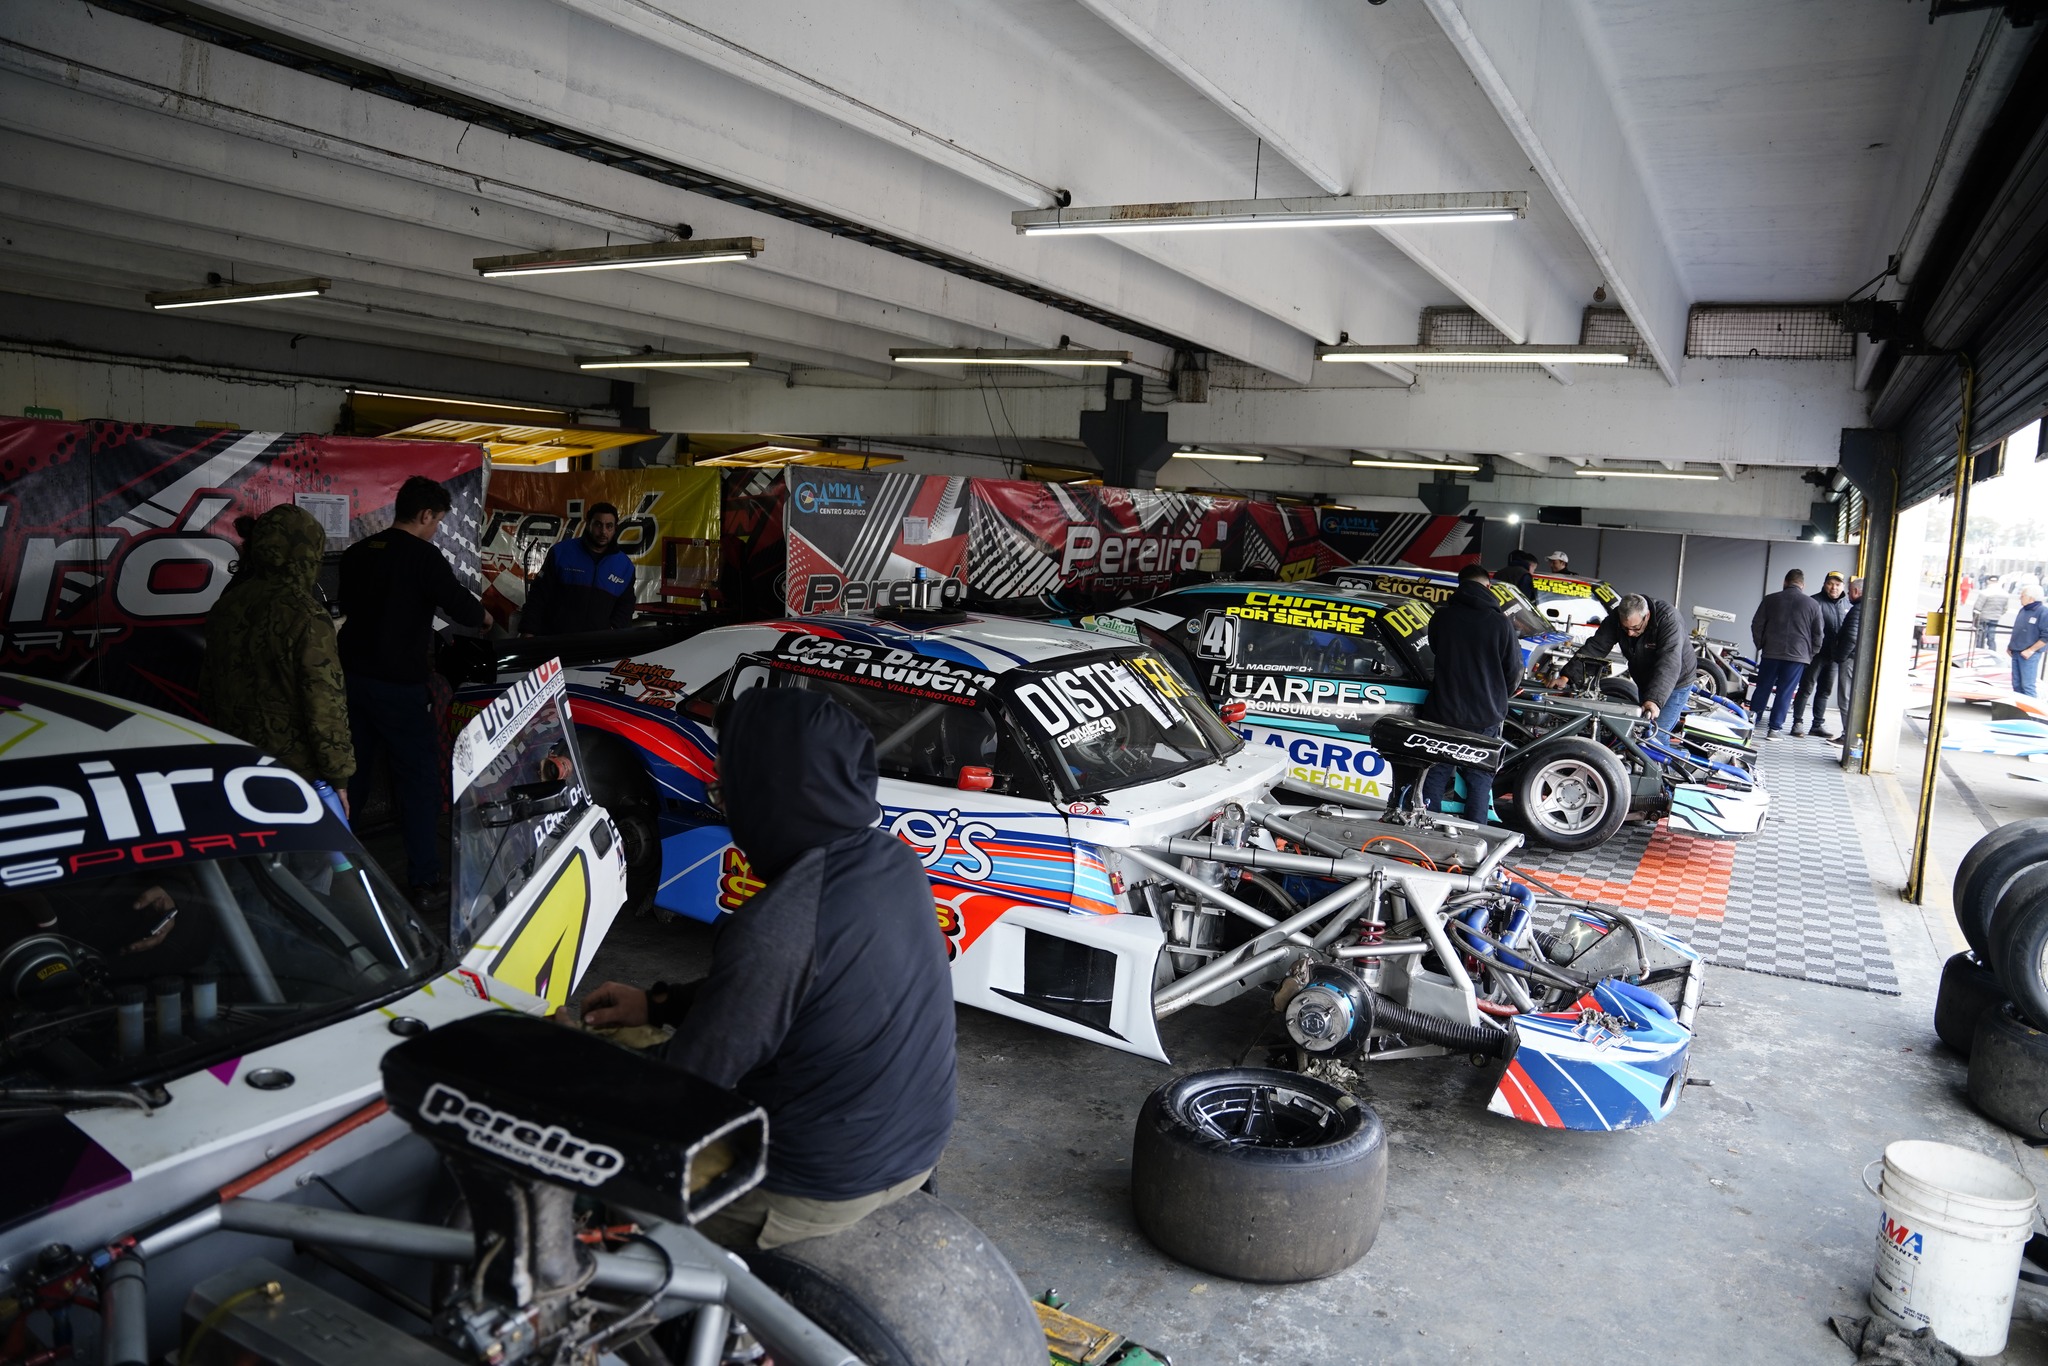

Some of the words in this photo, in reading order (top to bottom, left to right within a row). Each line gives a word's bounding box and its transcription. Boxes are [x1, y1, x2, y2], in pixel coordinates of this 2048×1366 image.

[795, 481, 866, 514] GAMMA
[819, 508, 841, 516] CENTRO
[843, 508, 866, 516] GRAFICO
[1060, 524, 1203, 576] Pereiró
[606, 573, 625, 584] NP
[1094, 576, 1139, 587] MOTOR
[1141, 572, 1172, 585] SPOR
[1226, 607, 1269, 621] POR
[1273, 611, 1365, 635] SIEMPRE
[610, 657, 675, 678] Logistica
[778, 635, 873, 671] Casa
[855, 648, 997, 697] Ruben
[887, 680, 977, 708] VIALES/MOTORES
[495, 697, 540, 751] DISTRIBUIDORA
[537, 690, 548, 707] DE
[1225, 697, 1331, 718] AROINSUMOS
[1334, 710, 1362, 721] S.A.
[1056, 719, 1105, 749] GOMEZ
[1104, 716, 1117, 733] 9
[1288, 767, 1380, 797] SECHA
[424, 1086, 620, 1172] pereiro
